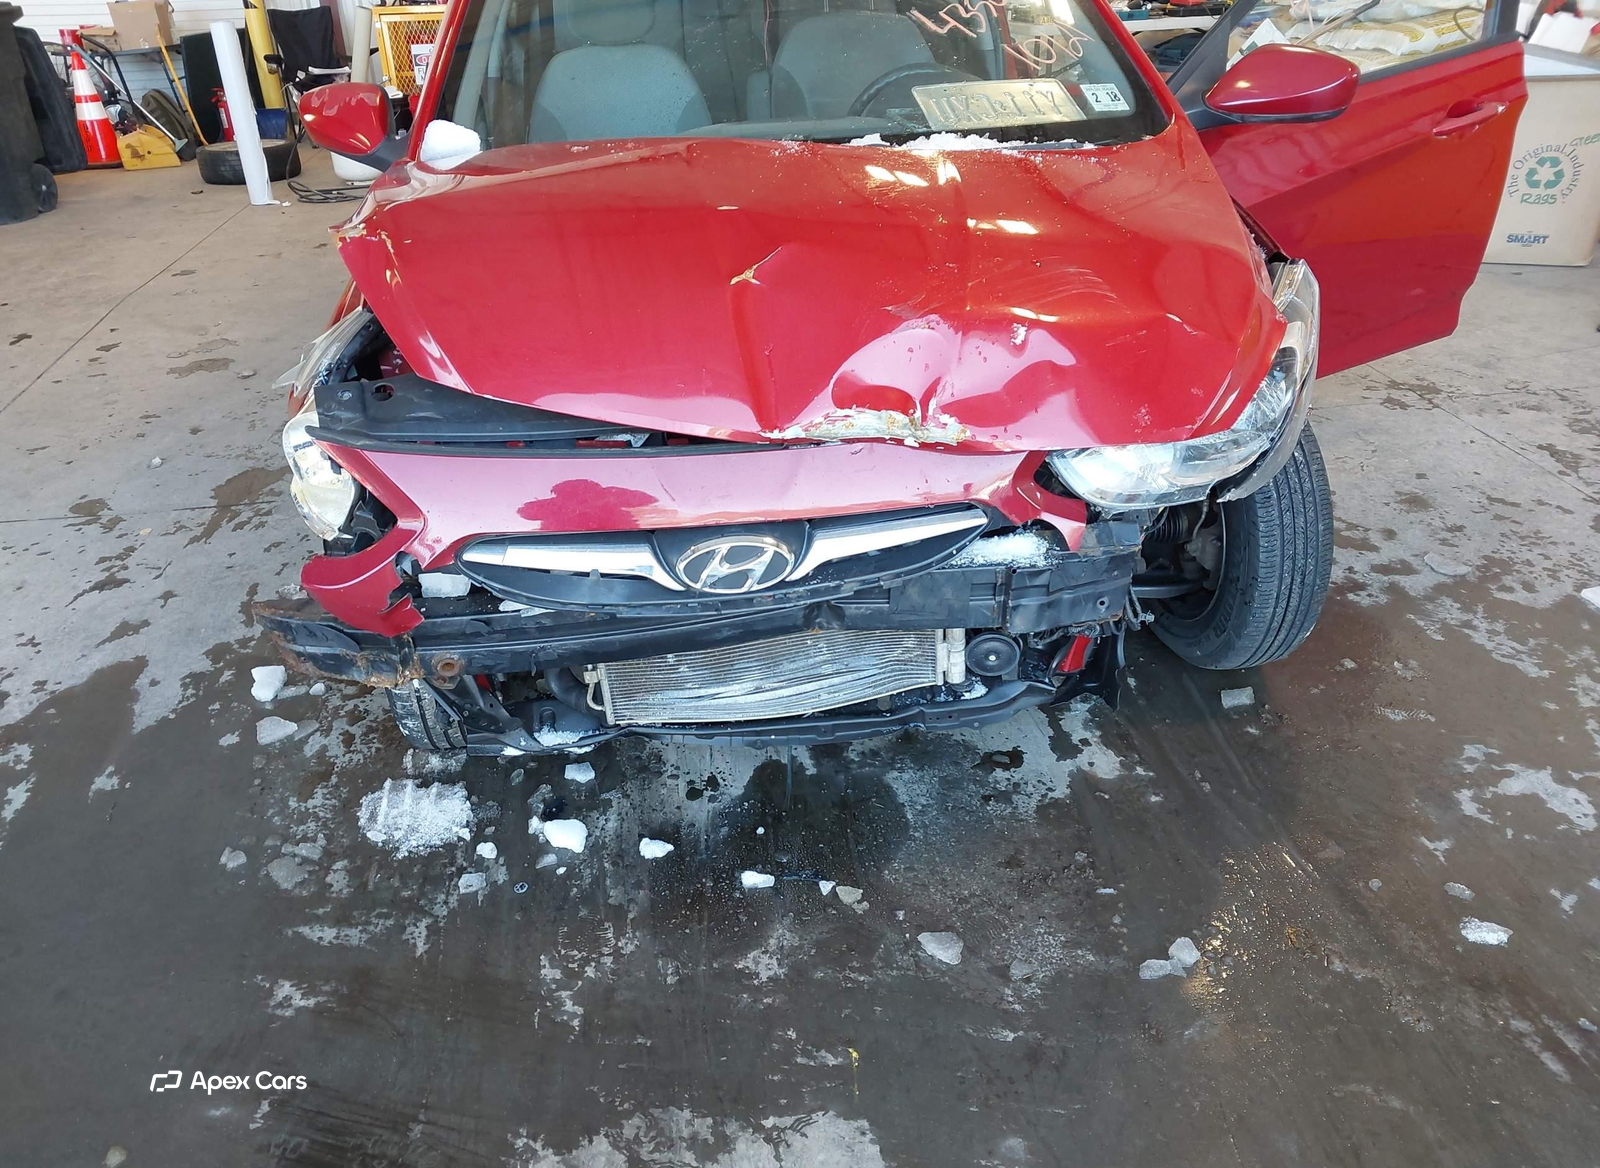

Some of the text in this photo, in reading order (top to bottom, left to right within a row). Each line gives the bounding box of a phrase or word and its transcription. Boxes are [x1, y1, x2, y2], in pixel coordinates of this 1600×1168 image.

[1091, 91, 1121, 103] 2 18
[1569, 132, 1600, 147] Gree
[1513, 143, 1568, 170] Original
[1507, 174, 1520, 198] The
[1520, 192, 1557, 205] Rags
[1506, 234, 1550, 244] SMART
